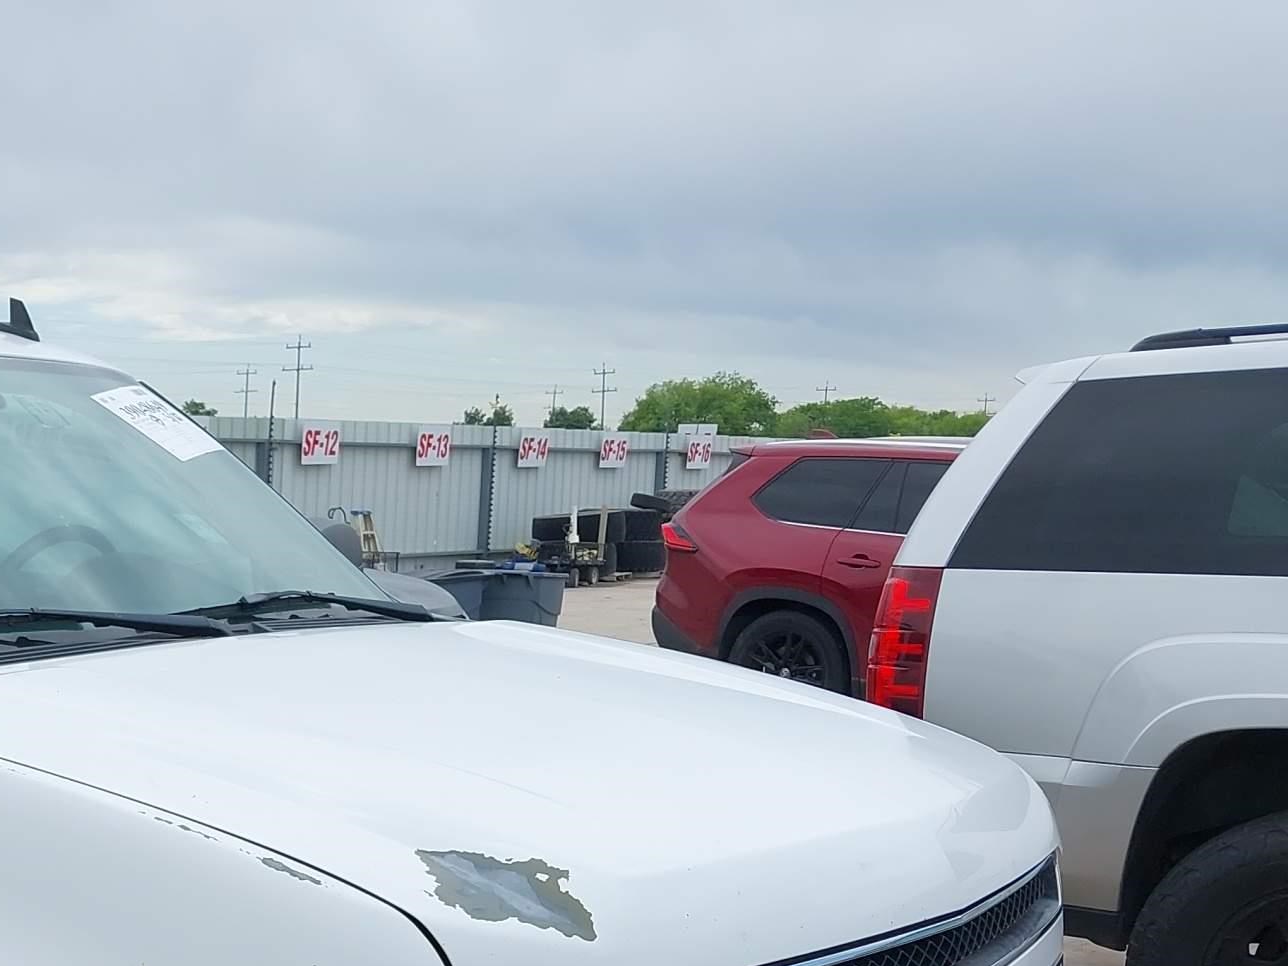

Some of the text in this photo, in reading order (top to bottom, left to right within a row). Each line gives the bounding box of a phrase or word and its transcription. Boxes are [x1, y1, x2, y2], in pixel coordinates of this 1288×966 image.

[303, 430, 339, 457] SF-12
[418, 434, 450, 458] SF-13
[519, 437, 548, 460] SF-14
[600, 440, 627, 461] SF-15
[687, 442, 711, 463] SF-16
